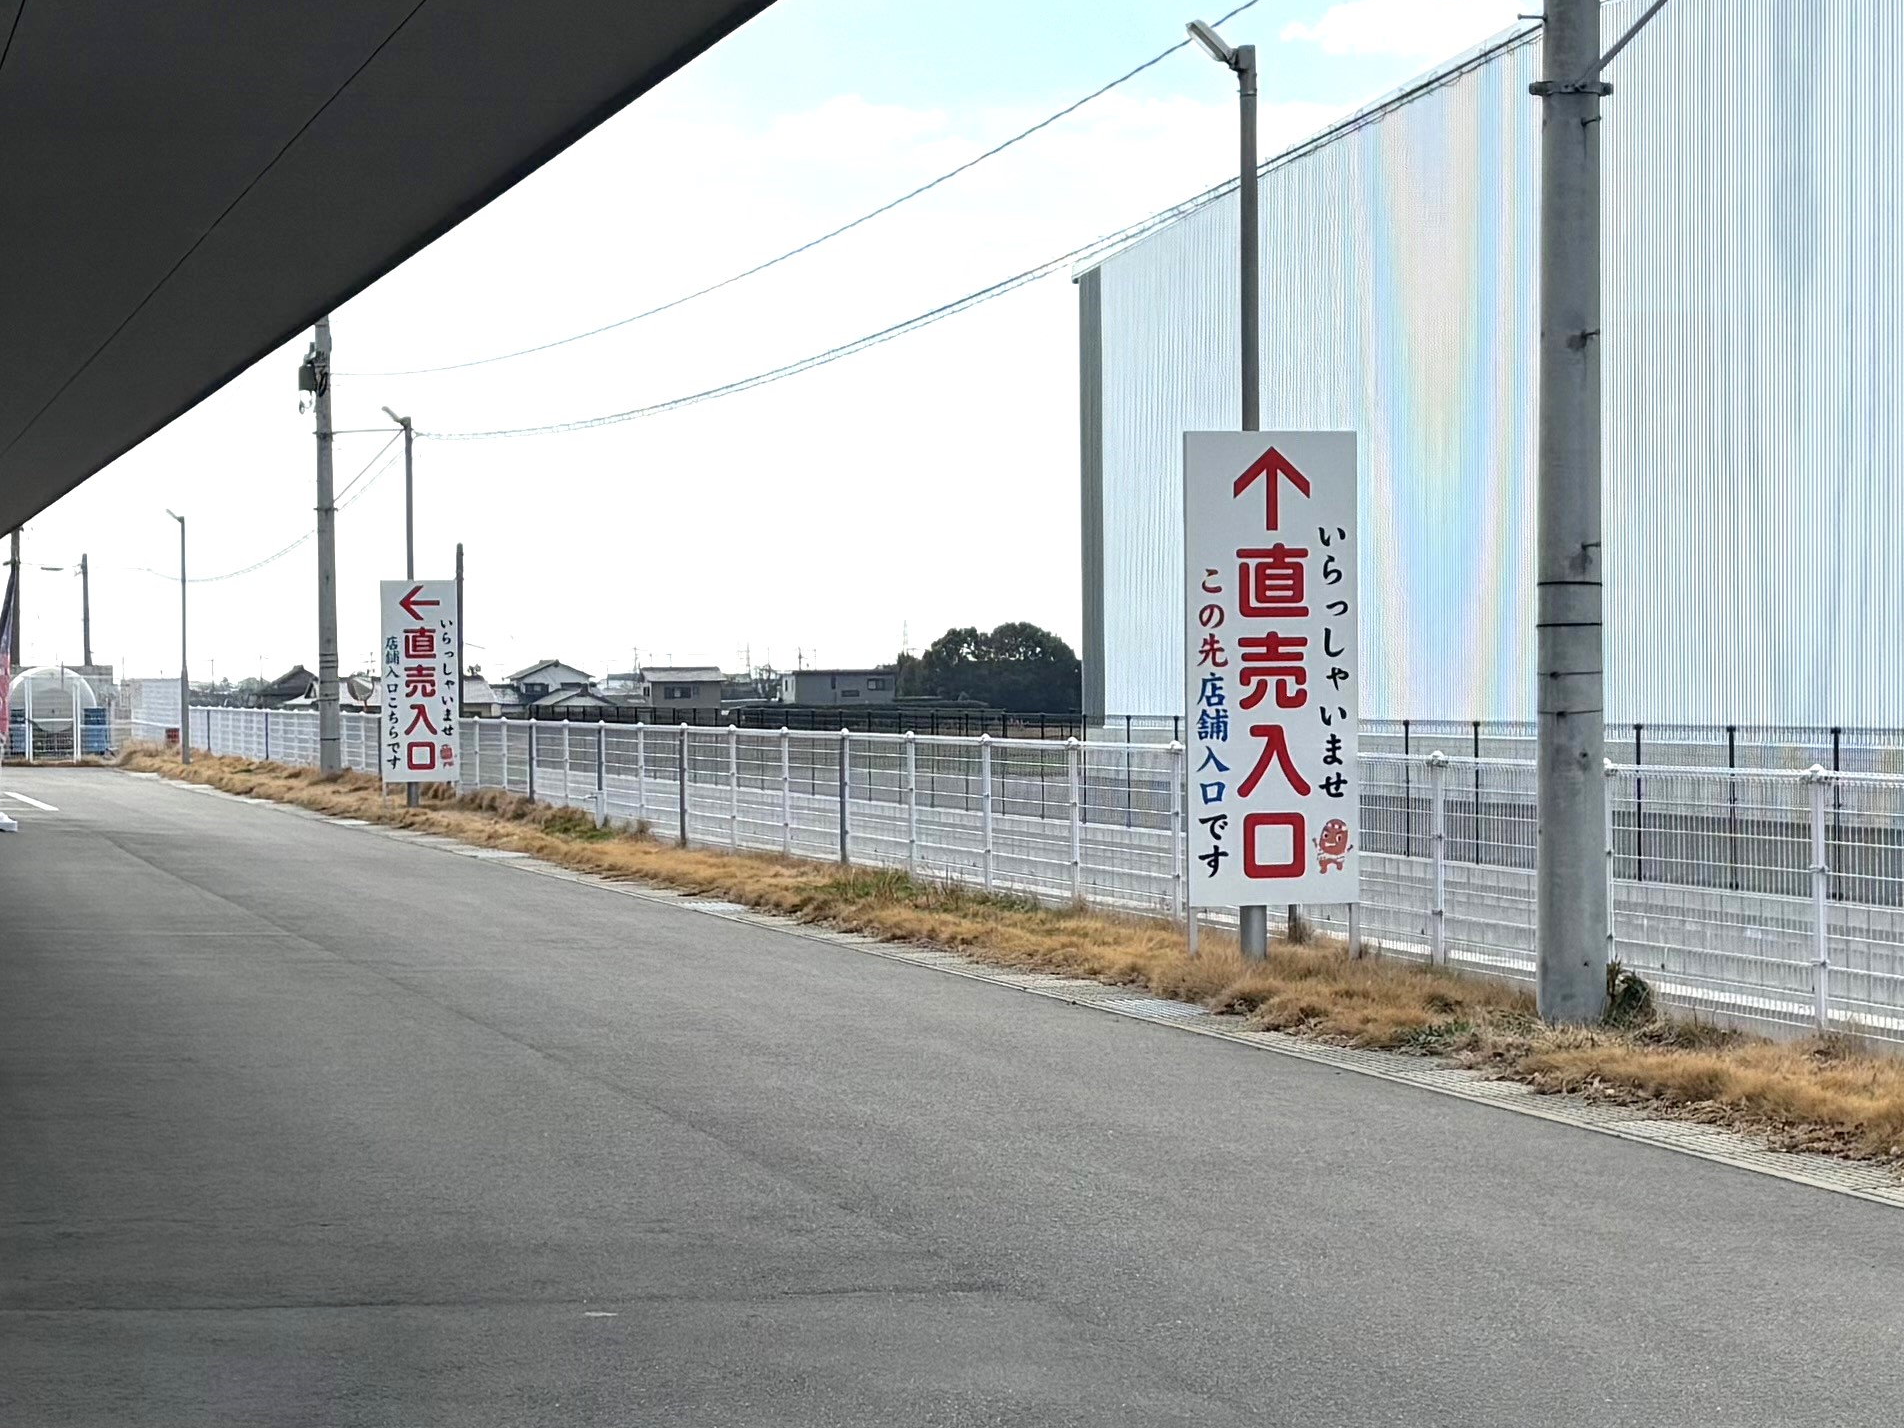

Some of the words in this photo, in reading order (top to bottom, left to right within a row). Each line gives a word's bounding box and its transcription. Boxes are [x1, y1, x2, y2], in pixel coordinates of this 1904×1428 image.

[385, 636, 401, 769] 店舗入口こちらです
[404, 627, 437, 770] 直売入口
[440, 619, 455, 738] いらっしゃいませ
[1196, 568, 1230, 877] この先店舗入口です
[1236, 543, 1311, 879] 直売入口
[1318, 525, 1349, 799] いらっしゃいませ
